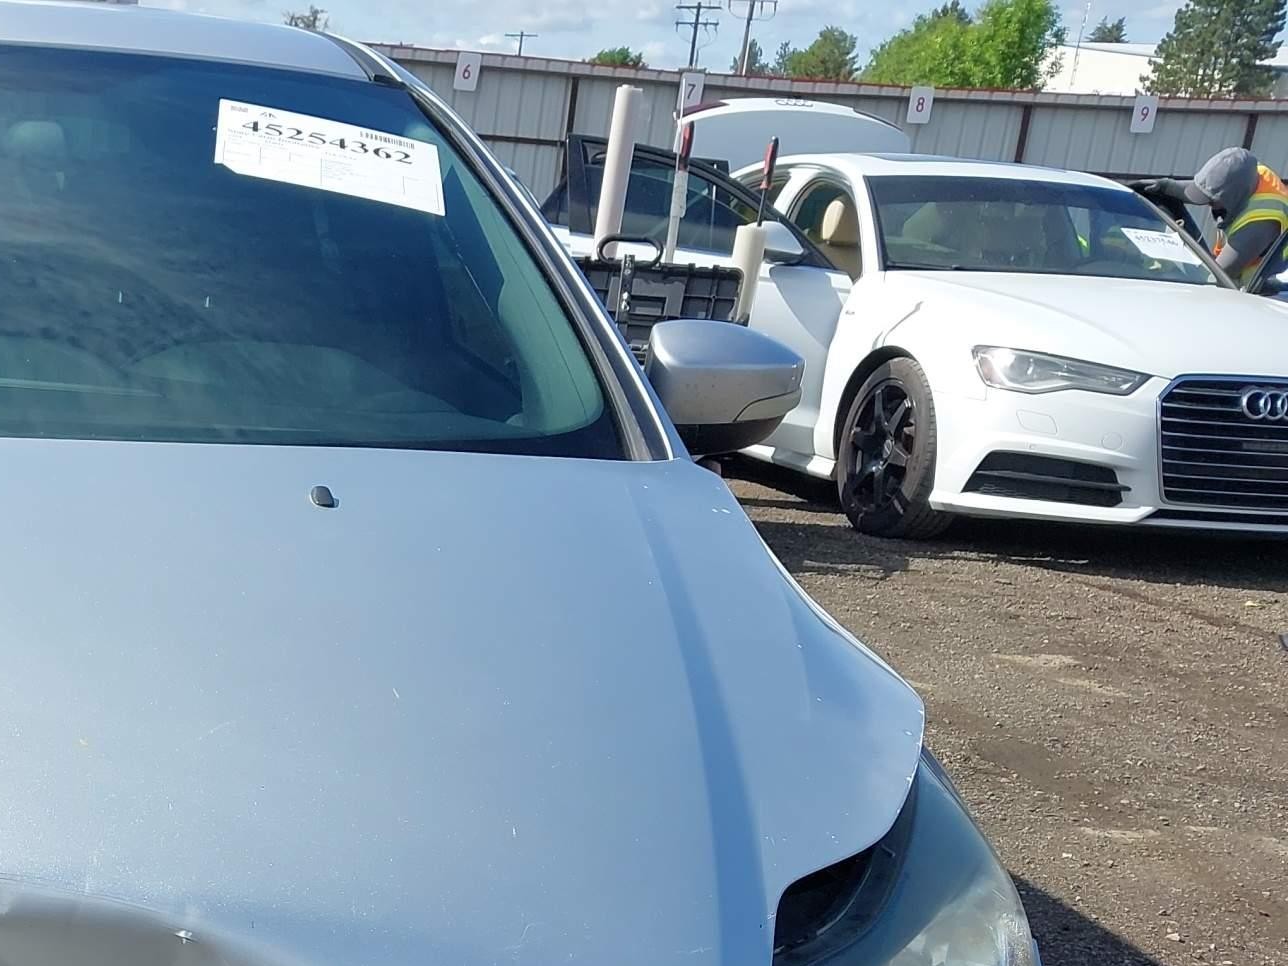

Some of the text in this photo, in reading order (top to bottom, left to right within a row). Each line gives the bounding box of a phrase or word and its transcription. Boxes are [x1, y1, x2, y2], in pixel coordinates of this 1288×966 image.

[462, 64, 471, 80] 6
[687, 84, 697, 99] 7
[916, 96, 925, 112] 8
[1141, 106, 1150, 121] 9
[242, 120, 414, 164] 45254362
